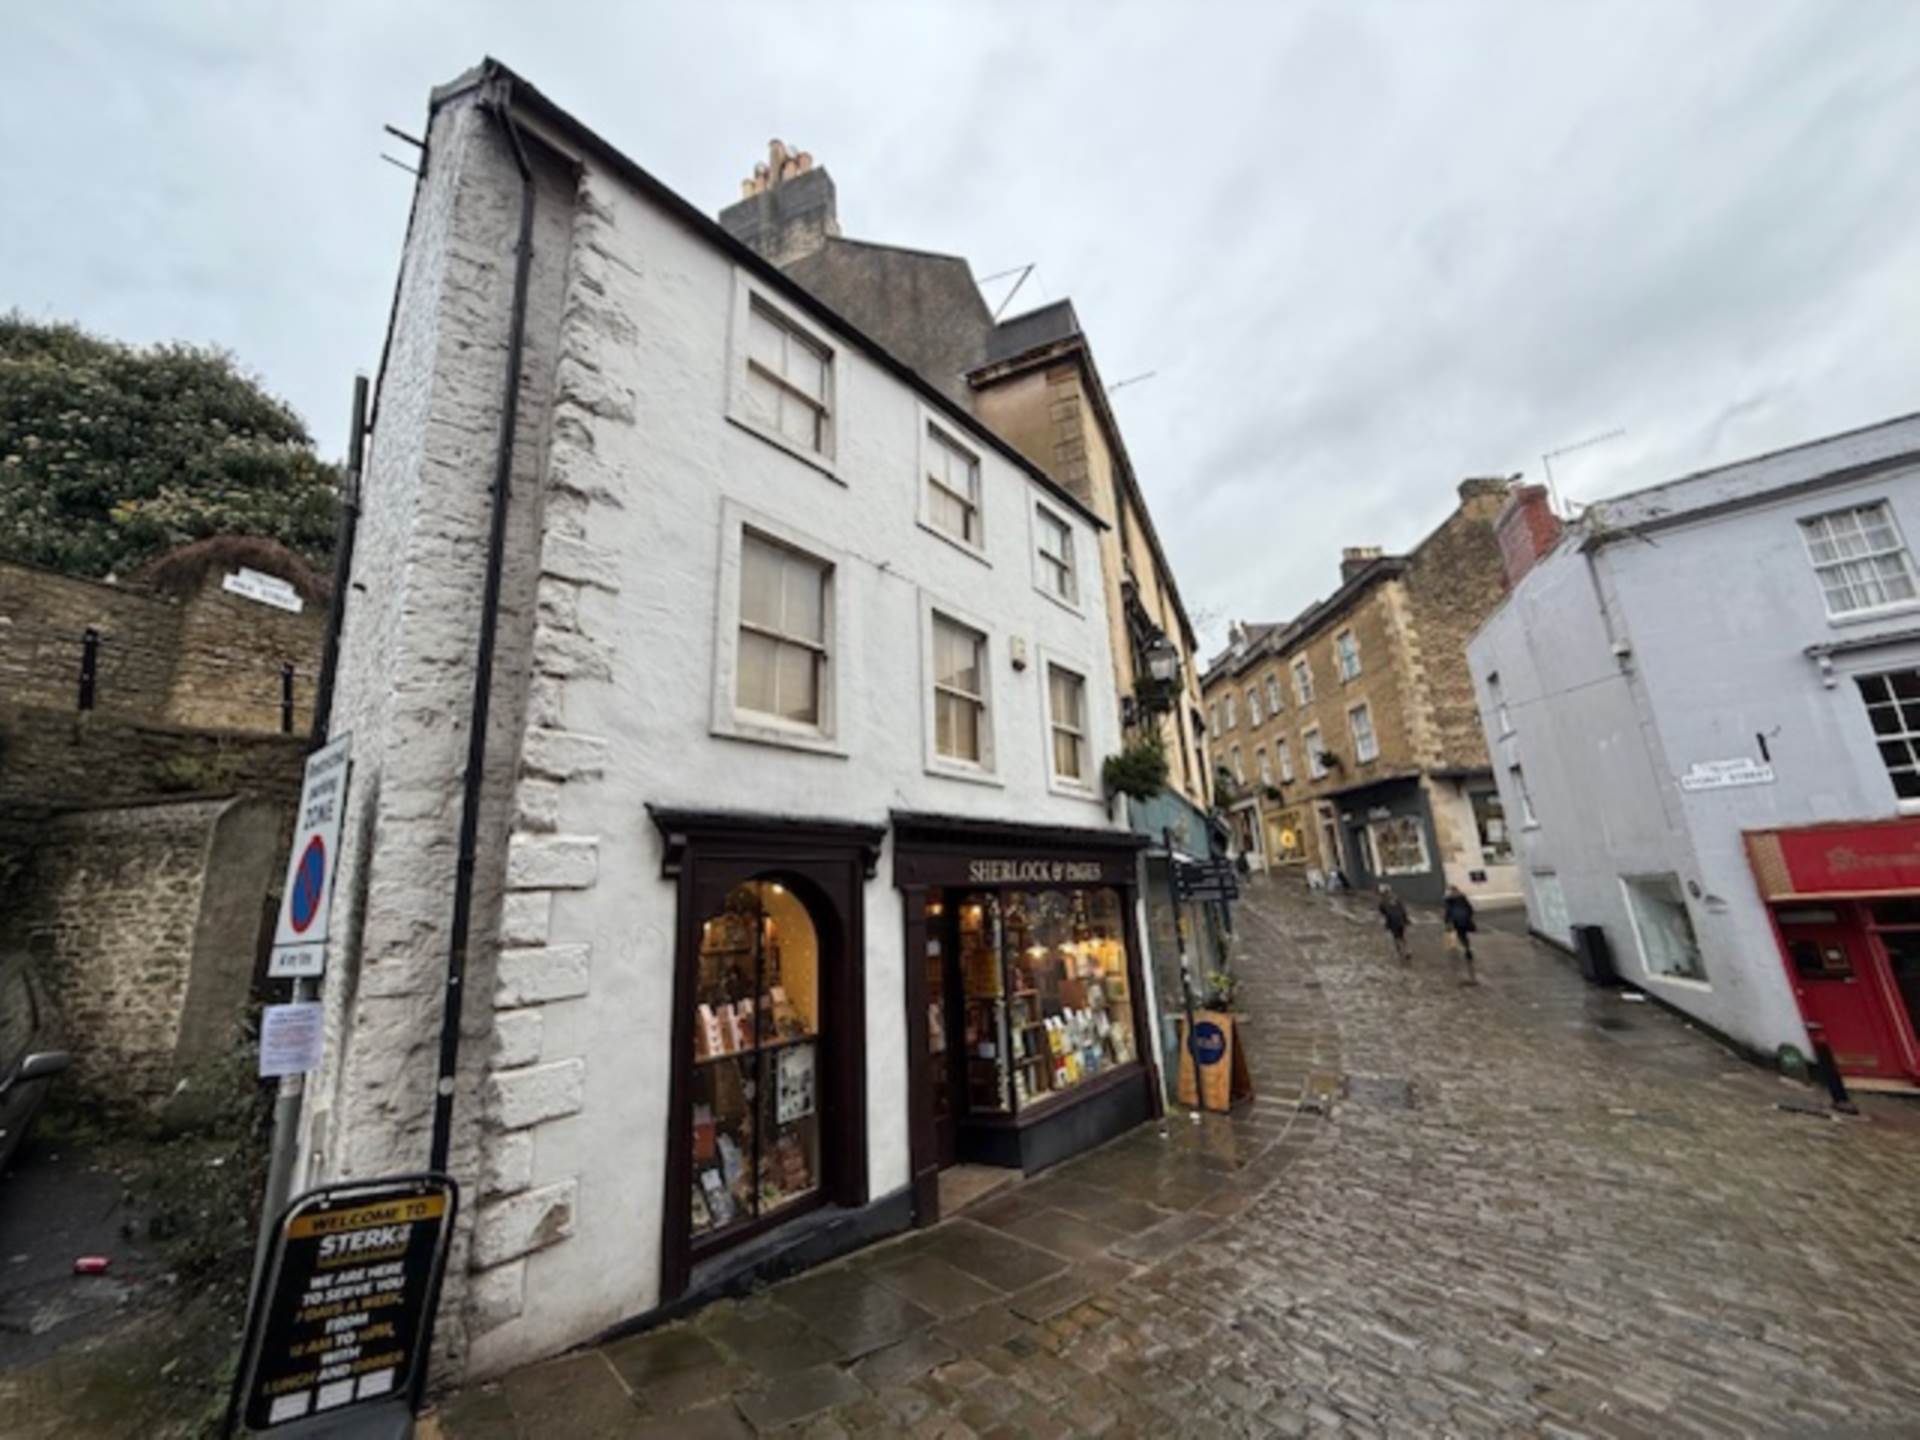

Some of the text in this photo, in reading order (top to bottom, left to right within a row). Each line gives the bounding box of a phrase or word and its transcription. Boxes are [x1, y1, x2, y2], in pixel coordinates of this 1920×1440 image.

[968, 859, 1051, 882] SHERLOCK
[1065, 861, 1103, 881] PAGES
[312, 1203, 428, 1232] WELCOME TO
[309, 1261, 405, 1290] WE ARE HERE
[302, 1276, 406, 1307] TO SERVE YOU
[325, 1312, 370, 1335] FROM
[335, 1331, 357, 1347] TO
[317, 1363, 352, 1382] AND
